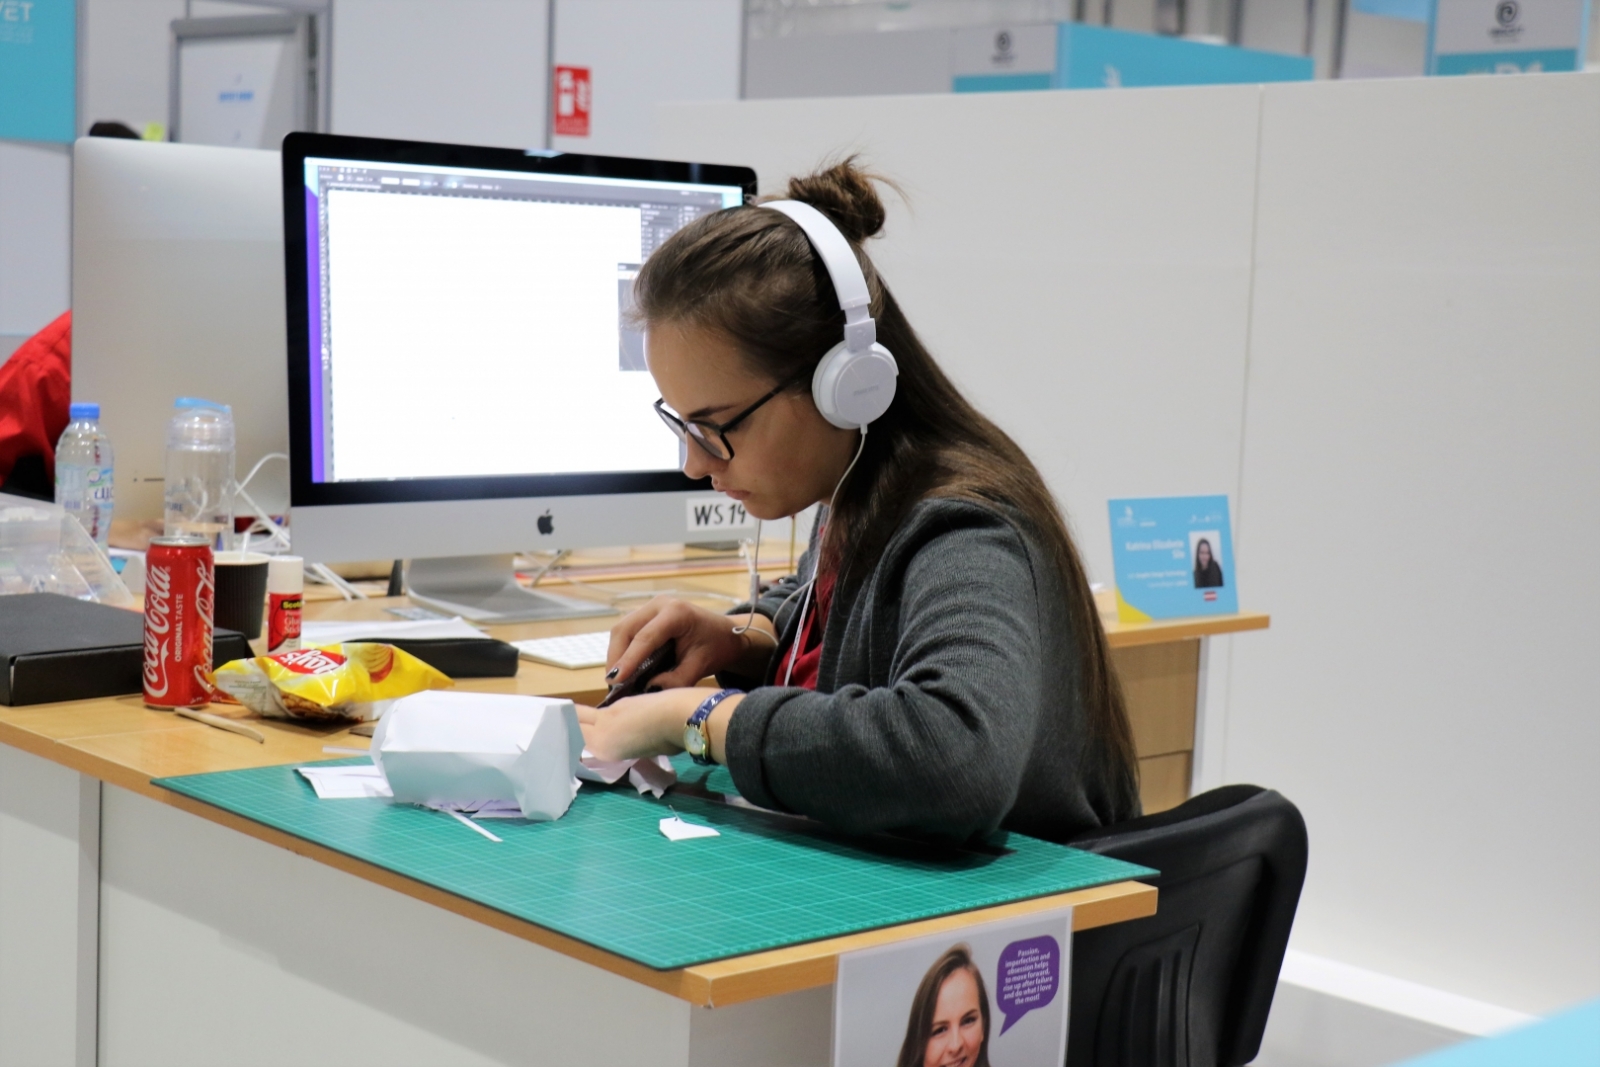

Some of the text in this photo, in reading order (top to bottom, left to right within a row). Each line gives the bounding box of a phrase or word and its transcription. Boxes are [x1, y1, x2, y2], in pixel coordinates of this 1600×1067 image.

[694, 503, 746, 526] WS 14
[143, 564, 171, 698] Coca-Cola
[175, 593, 183, 662] ORIGINAL TASTE
[280, 650, 340, 675] Lay's
[1005, 952, 1051, 968] imperfection and
[1007, 961, 1048, 976] obsession helps
[1022, 980, 1035, 988] after
[1036, 977, 1052, 985] failure
[1004, 992, 1014, 1000] and
[1023, 988, 1036, 996] what
